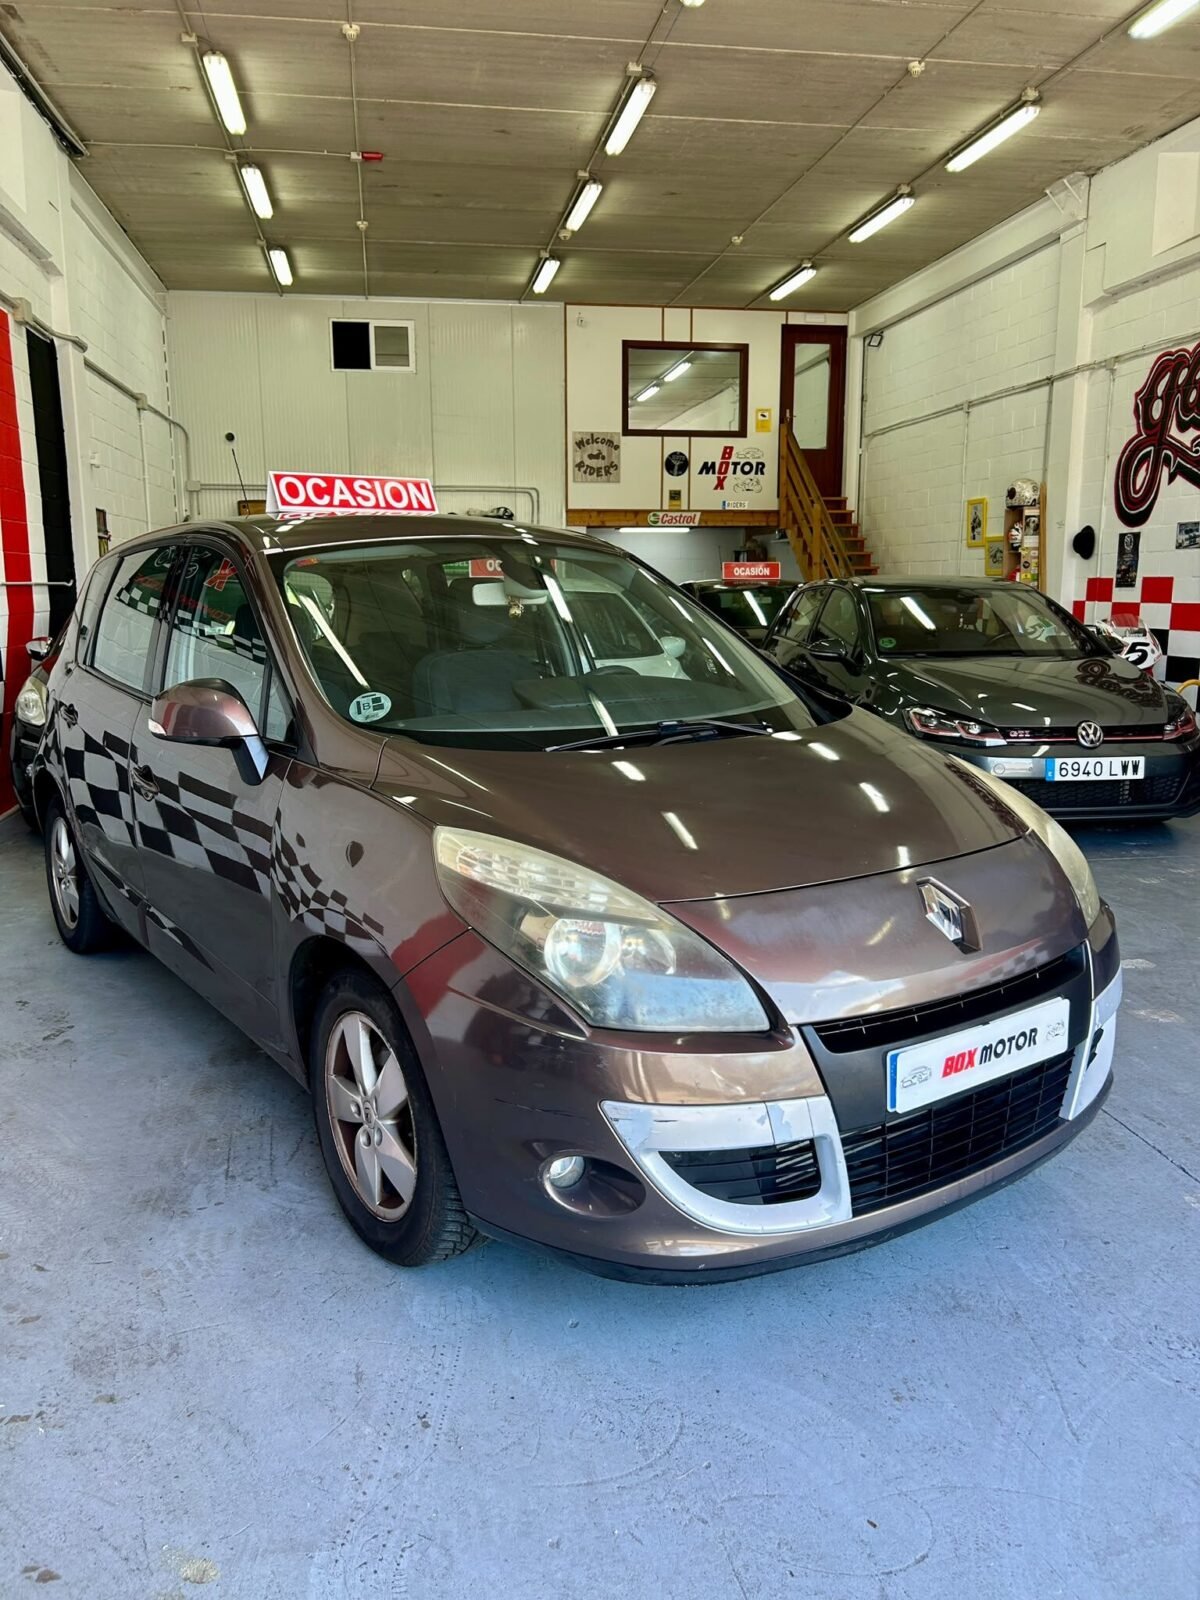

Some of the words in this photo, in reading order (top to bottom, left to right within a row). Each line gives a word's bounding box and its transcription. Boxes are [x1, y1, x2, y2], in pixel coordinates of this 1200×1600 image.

[575, 433, 620, 451] Welcome
[575, 460, 619, 478] RIDERS
[278, 476, 433, 510] OCASION
[660, 513, 697, 525] Castrol
[1125, 641, 1150, 666] 5
[1059, 760, 1103, 778] 6940
[1109, 759, 1140, 777] LWW
[941, 1047, 979, 1078] BOX
[979, 1027, 1038, 1065] MOTOR
